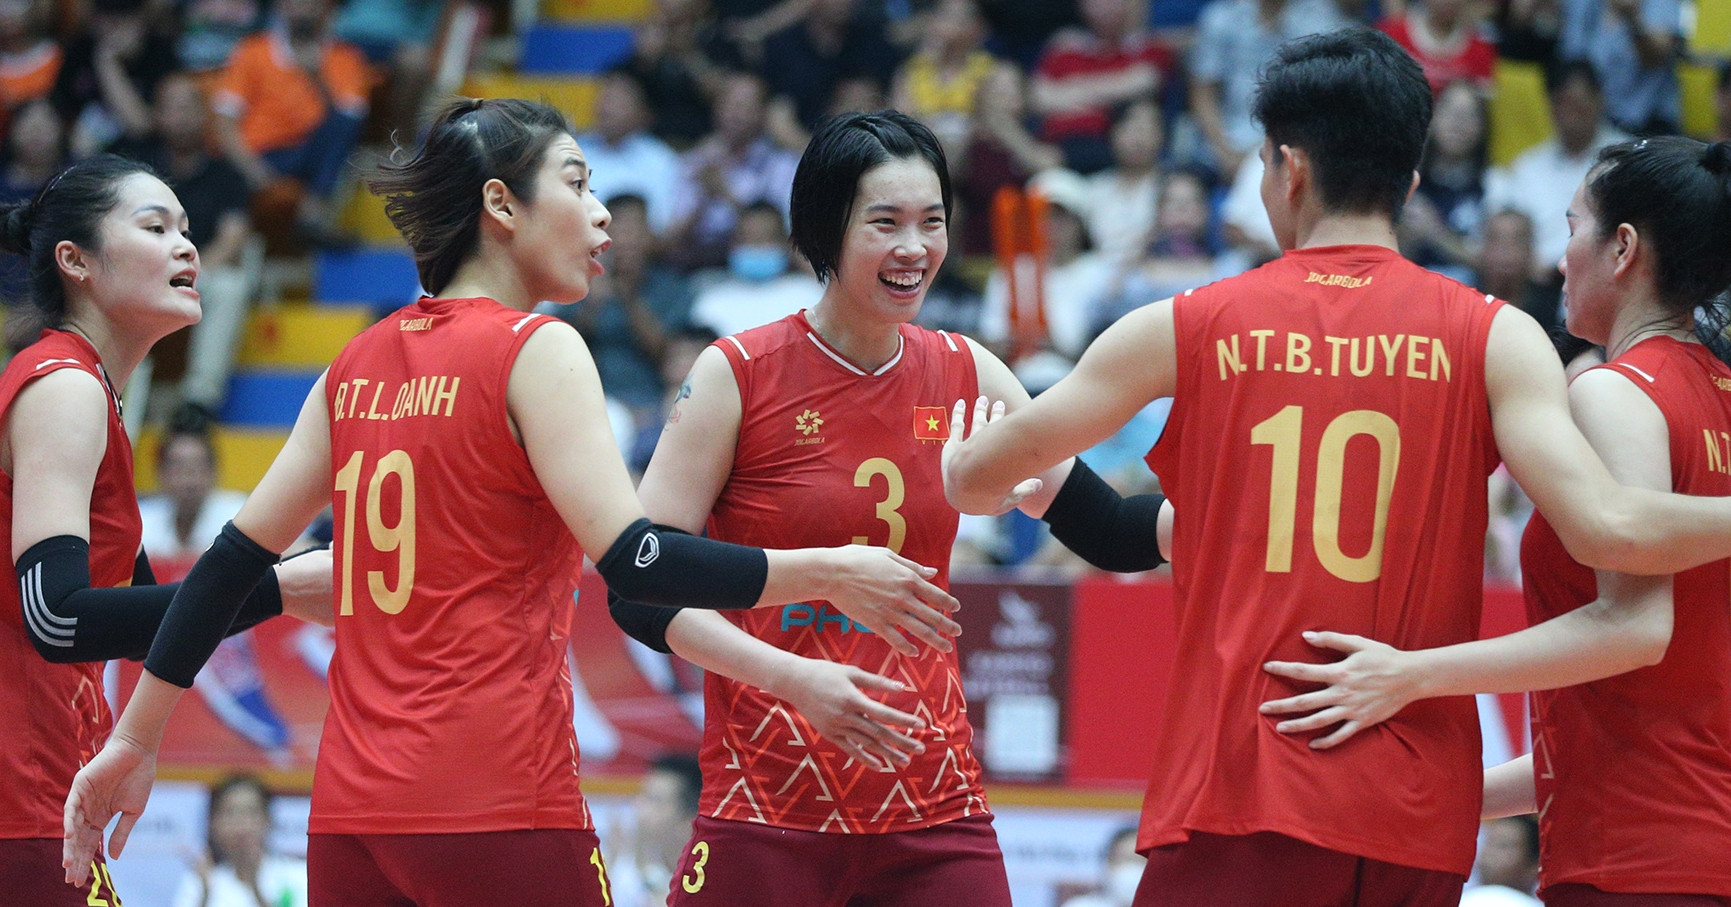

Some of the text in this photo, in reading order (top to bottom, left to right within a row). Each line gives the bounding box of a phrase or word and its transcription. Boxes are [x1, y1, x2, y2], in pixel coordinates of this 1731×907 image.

[1216, 329, 1451, 382] N.T.B.TUYEN
[334, 449, 416, 616] 19
[851, 457, 906, 555] 3
[1250, 405, 1401, 583] 10
[682, 841, 710, 894] 3
